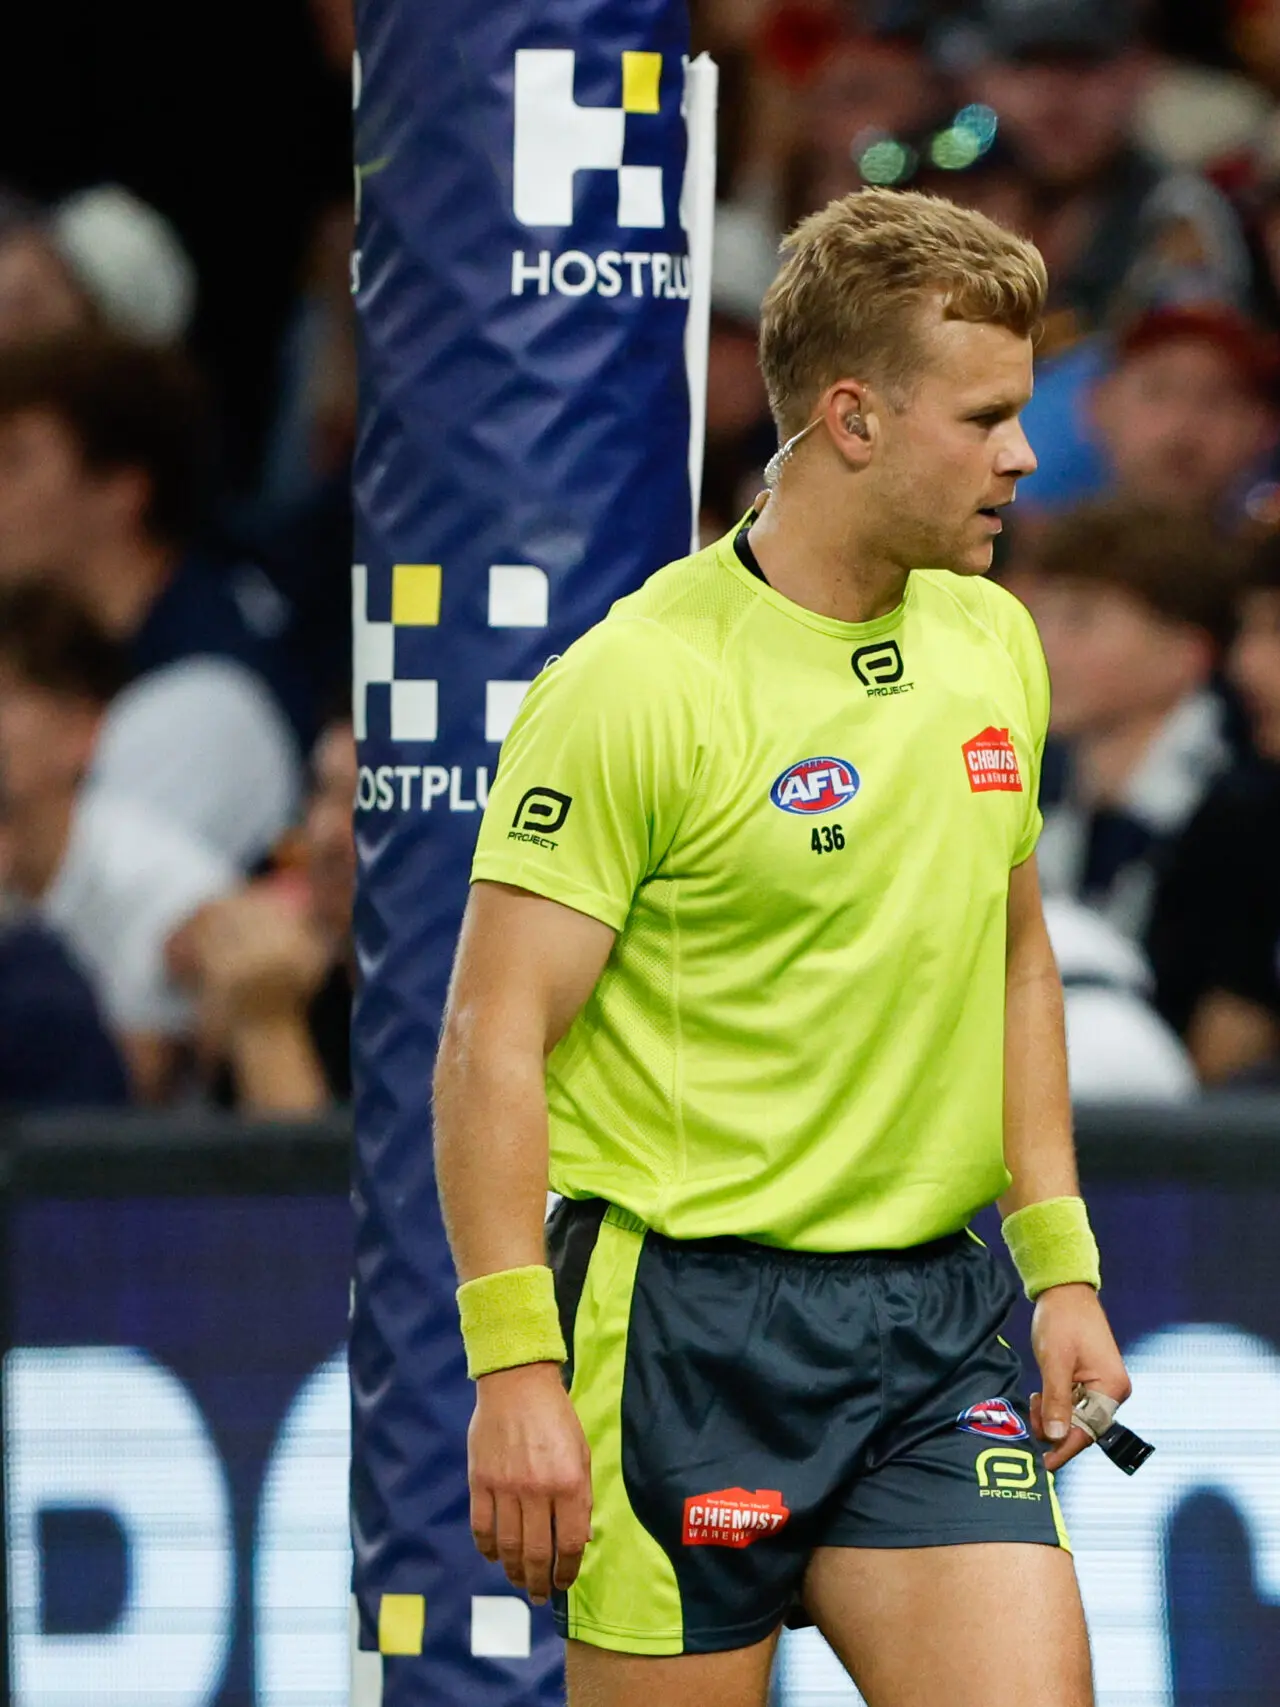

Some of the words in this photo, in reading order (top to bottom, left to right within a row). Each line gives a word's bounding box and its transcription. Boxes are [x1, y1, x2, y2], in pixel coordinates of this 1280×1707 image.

[867, 682, 915, 699] PROJECT
[354, 765, 489, 812] OSTPL
[780, 767, 856, 806] AFL
[507, 831, 559, 851] PROJECT
[811, 823, 846, 855] 436
[979, 1489, 1043, 1501] PROJECT
[689, 1506, 783, 1530] CHEMIST
